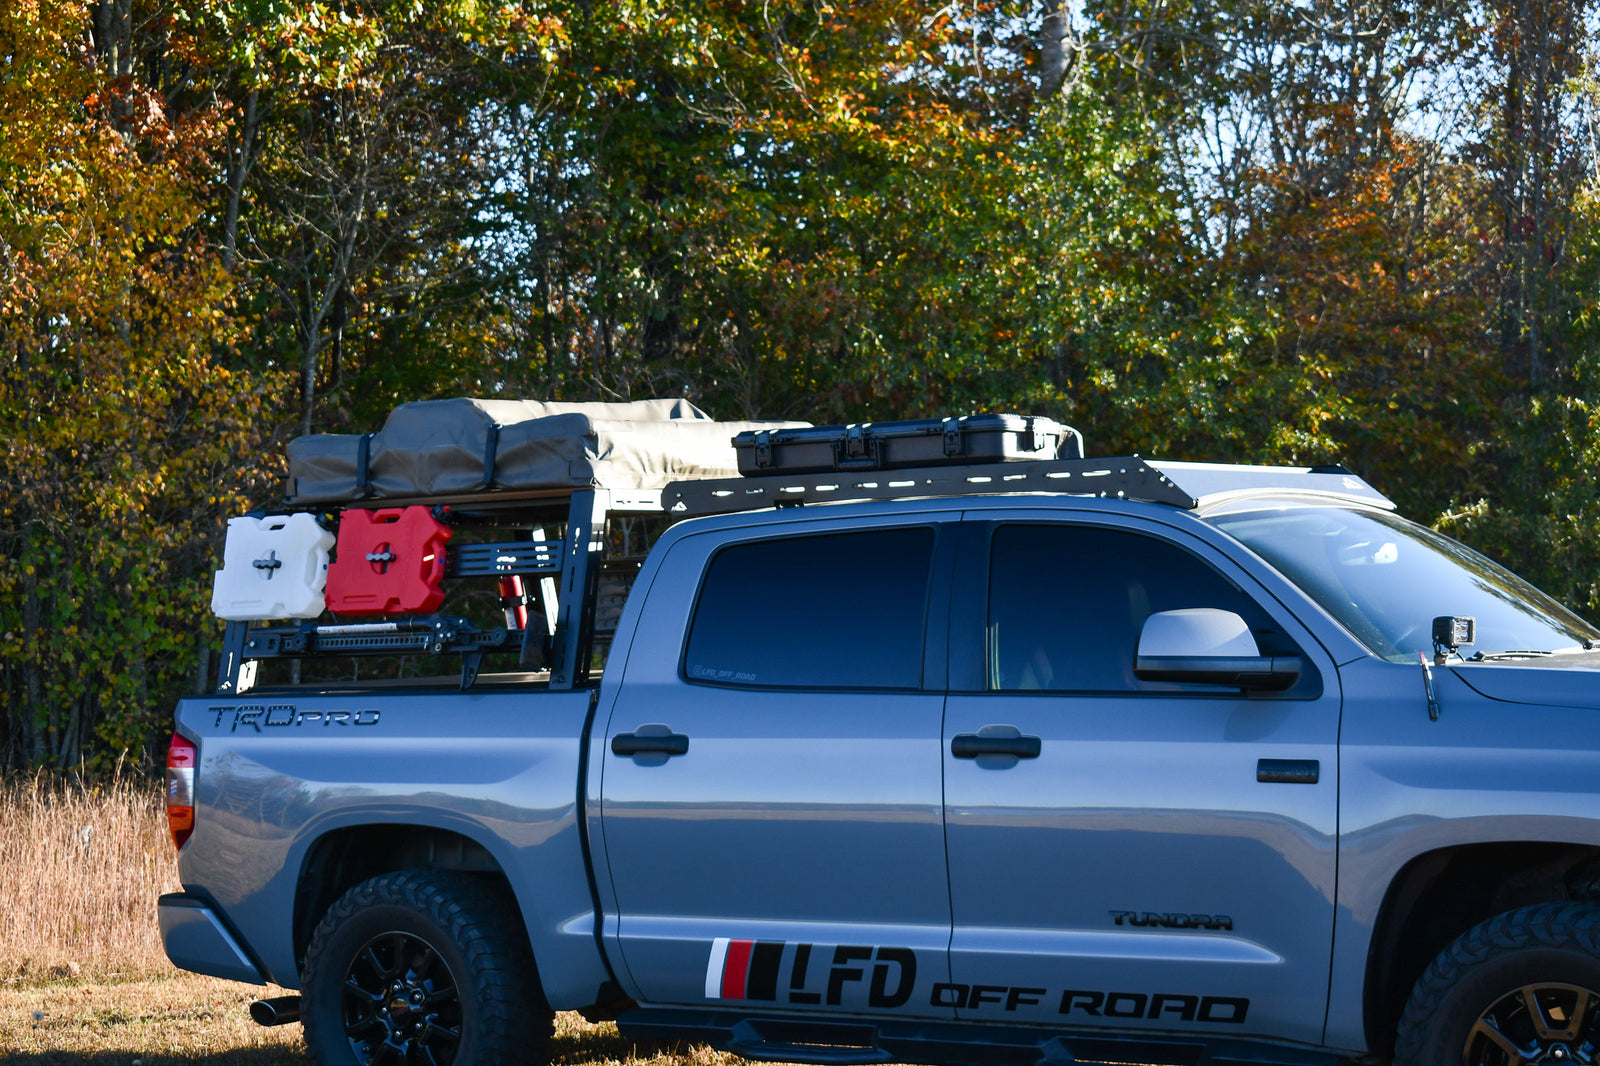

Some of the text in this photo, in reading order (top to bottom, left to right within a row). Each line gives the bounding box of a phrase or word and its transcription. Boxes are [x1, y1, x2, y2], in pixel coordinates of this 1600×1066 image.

[208, 704, 381, 733] TRD PRO
[1108, 910, 1233, 931] TUNDRA
[789, 943, 1250, 1024] LFD OFF ROAD
